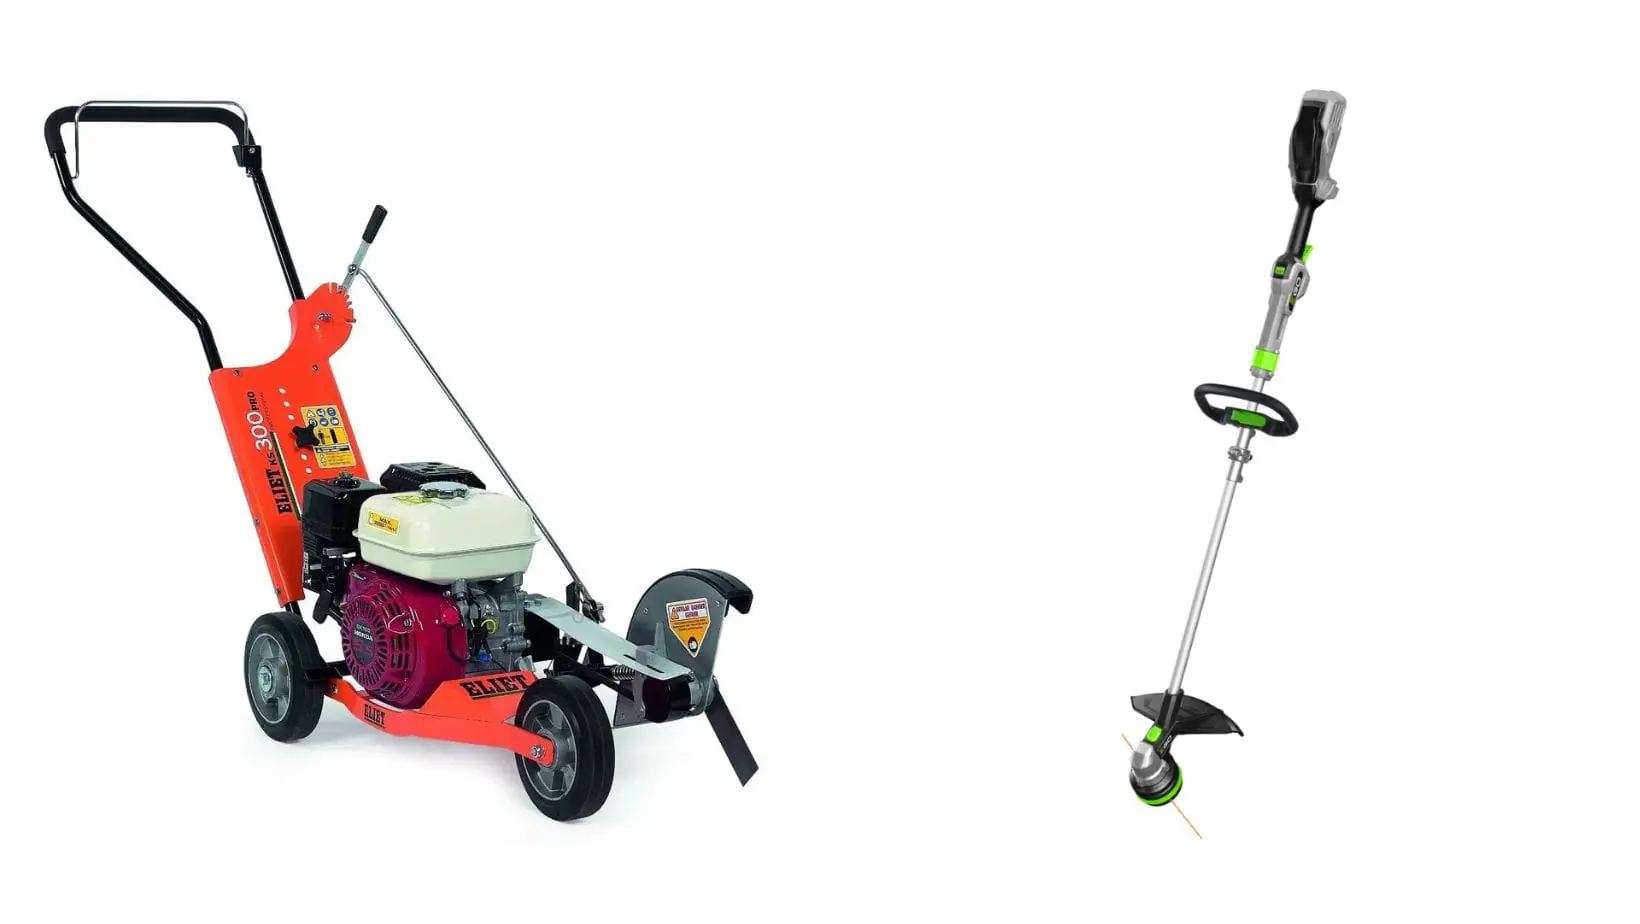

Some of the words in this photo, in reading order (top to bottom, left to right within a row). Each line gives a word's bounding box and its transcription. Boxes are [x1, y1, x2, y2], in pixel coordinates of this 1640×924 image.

[247, 391, 259, 411] PRO
[246, 411, 273, 451] 300
[267, 452, 277, 466] KS
[265, 468, 293, 514] ELIET
[354, 629, 374, 641] HONDA
[460, 674, 529, 697] ELIET
[364, 703, 385, 725] ELIET
